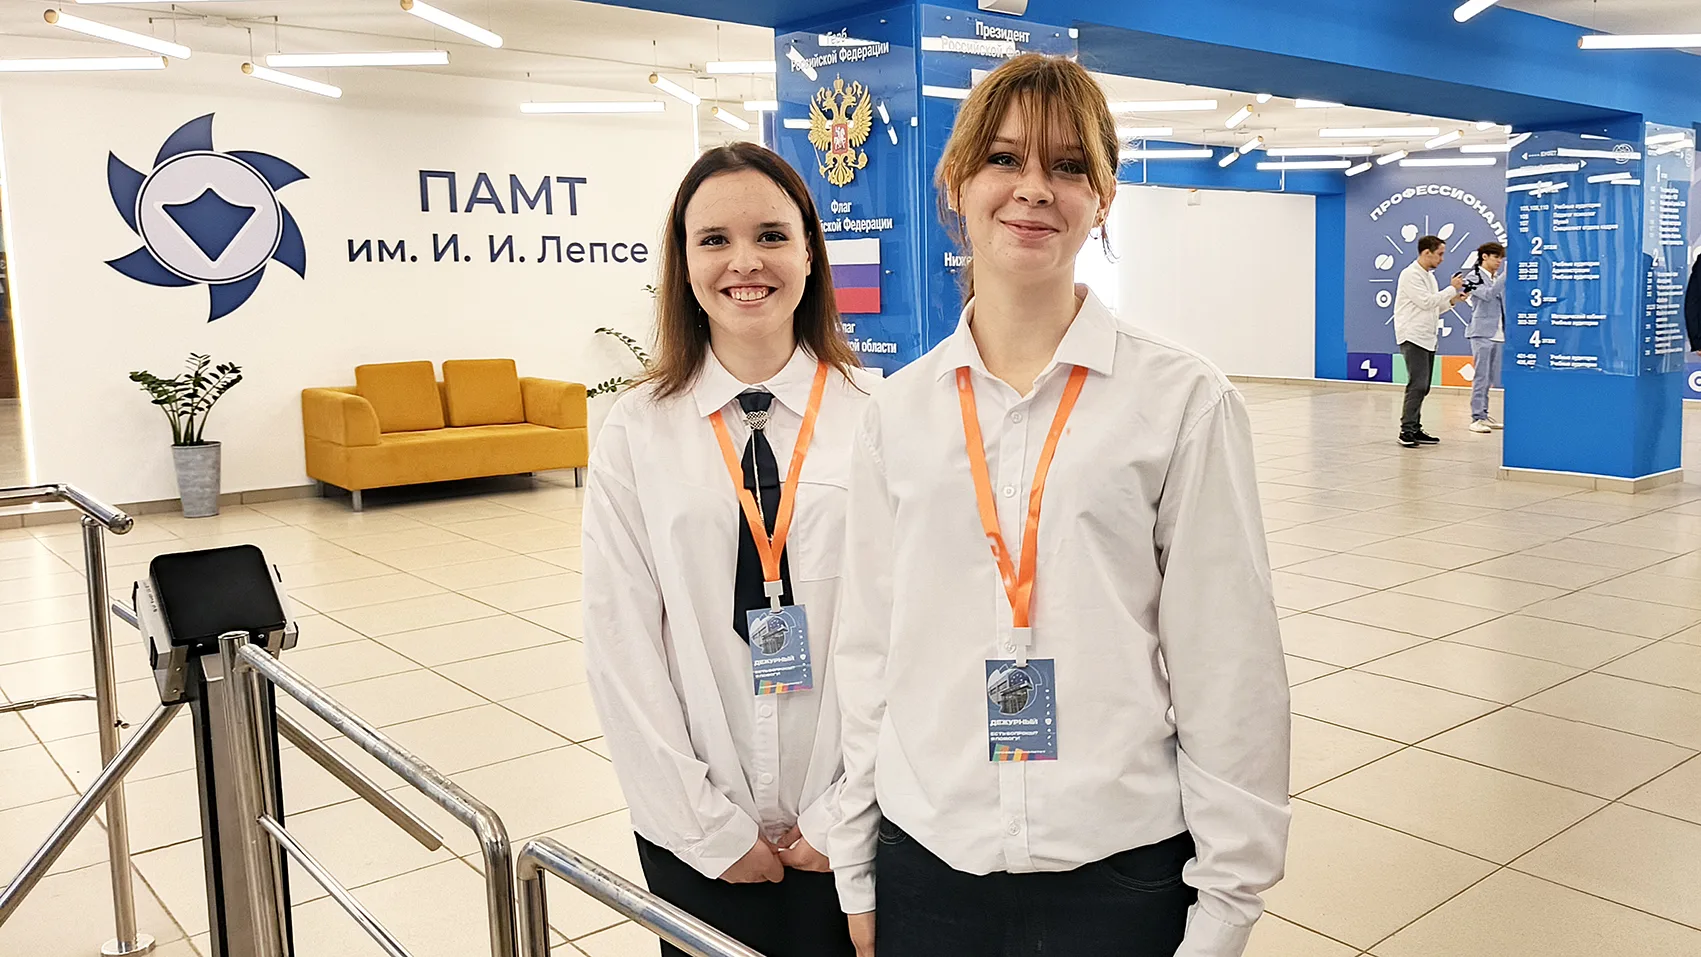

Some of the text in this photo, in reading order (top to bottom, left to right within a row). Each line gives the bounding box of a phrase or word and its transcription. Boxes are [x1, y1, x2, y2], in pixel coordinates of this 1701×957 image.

[827, 27, 847, 45] Герб
[975, 20, 1030, 43] Президент
[791, 42, 889, 72] Российской Федерации
[419, 170, 587, 215] ПАМТ
[830, 199, 852, 214] Флаг
[843, 217, 893, 233] Федерации
[1369, 184, 1508, 248] ПРОФЕССИОНАЛИ
[347, 233, 648, 263] им. И. И. Лепсе
[1531, 237, 1543, 255] 2
[1652, 249, 1659, 267] 2
[1530, 288, 1542, 307] 3
[835, 322, 855, 334] лаг
[861, 338, 897, 353] области
[1529, 330, 1541, 348] 4
[989, 718, 1039, 727] ДЕЖУРНЫЙ
